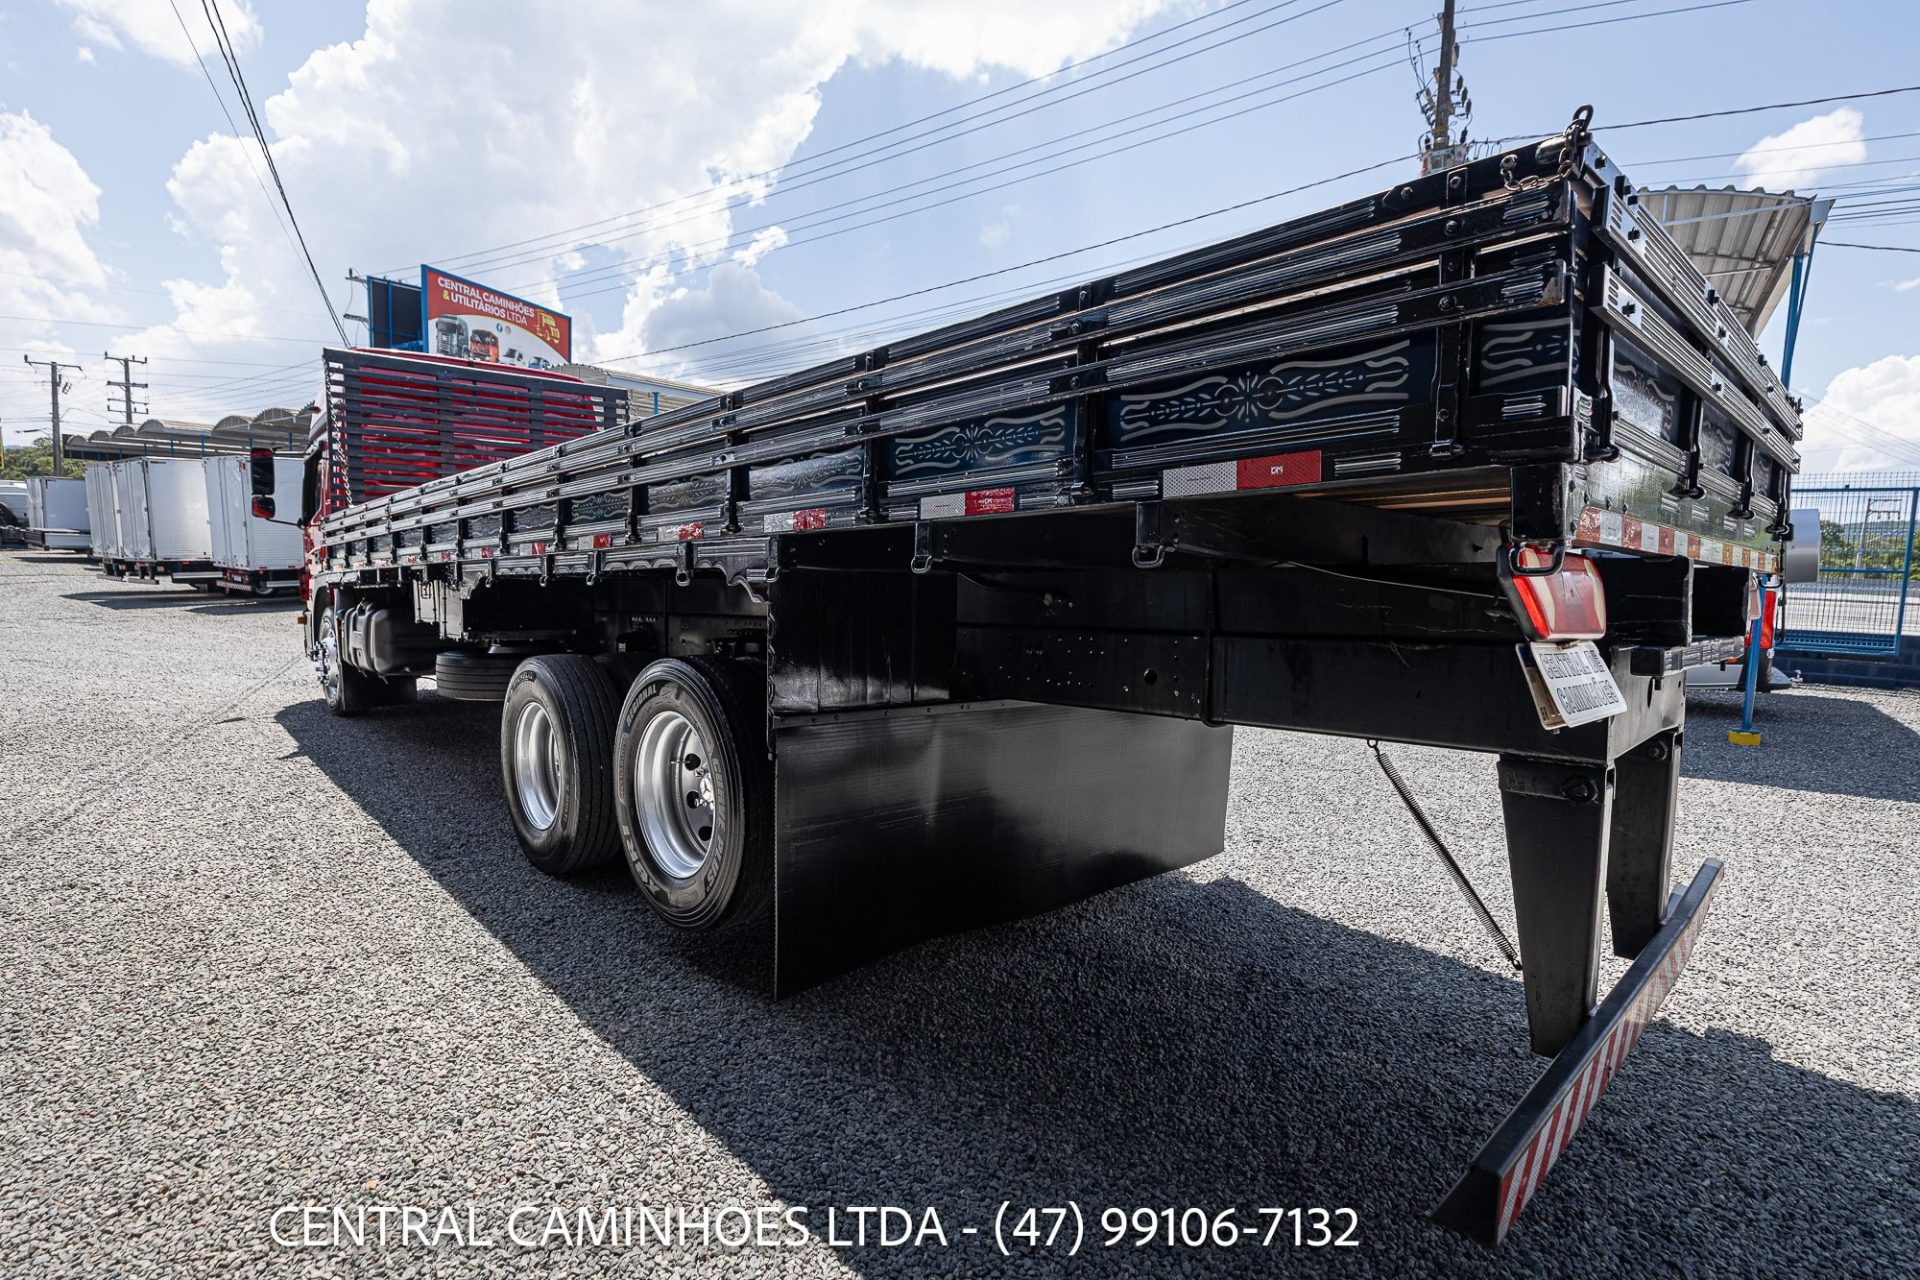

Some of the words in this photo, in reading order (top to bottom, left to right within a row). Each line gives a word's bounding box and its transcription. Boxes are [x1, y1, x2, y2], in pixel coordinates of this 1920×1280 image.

[438, 276, 482, 299] CENTRAL
[482, 292, 535, 317] CAMINHÕES
[443, 290, 450, 301] &
[451, 292, 506, 320] UTILITÁRIOS
[507, 311, 527, 325] LTDA
[1539, 651, 1592, 679] CENTRAL
[1583, 649, 1605, 673] DE
[1556, 677, 1619, 715] CAMINHÕES
